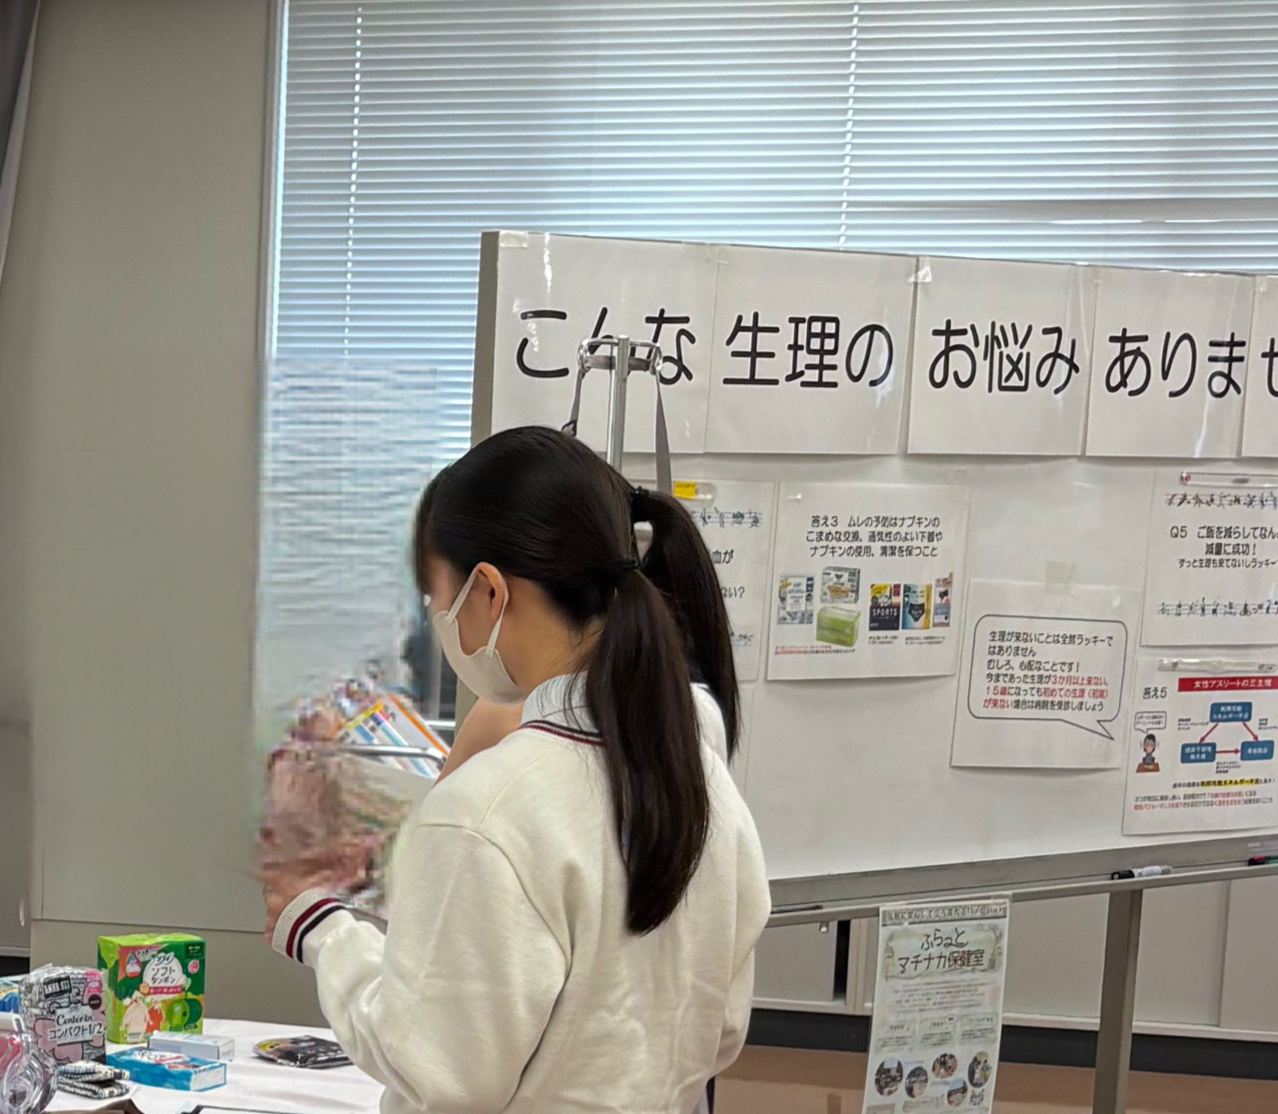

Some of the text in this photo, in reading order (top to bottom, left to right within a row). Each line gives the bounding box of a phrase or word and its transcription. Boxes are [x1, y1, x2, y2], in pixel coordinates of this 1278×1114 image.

[722, 311, 894, 388] 生理の
[929, 319, 1080, 395] お悩み
[1170, 526, 1188, 539] Q5
[987, 646, 1036, 657] はありません
[921, 928, 969, 951] ふらっと
[898, 949, 985, 974] マチナカ保健室
